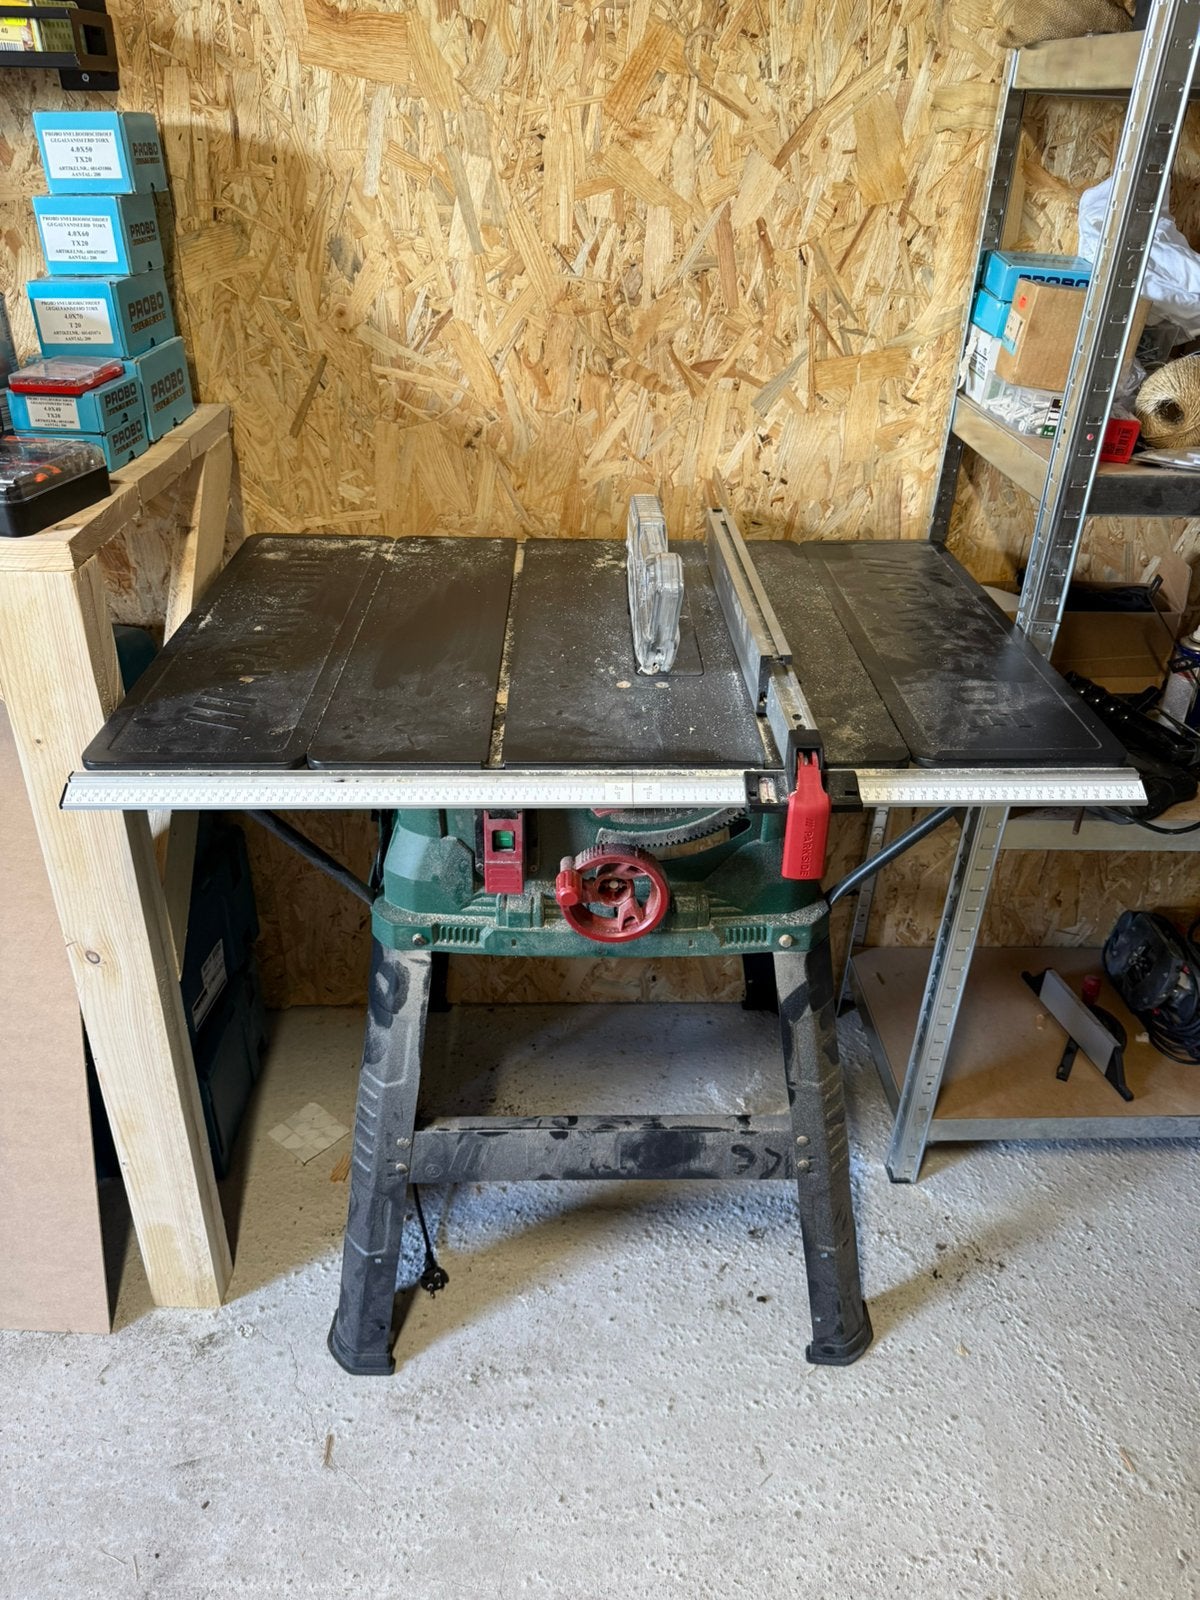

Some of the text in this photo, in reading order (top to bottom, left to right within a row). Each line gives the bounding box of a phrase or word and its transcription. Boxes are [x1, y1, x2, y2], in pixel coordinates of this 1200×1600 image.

[132, 142, 158, 156] PROBO
[129, 221, 155, 237] PROBO
[1019, 274, 1090, 287] OBO
[127, 291, 164, 321] PROBO
[105, 382, 137, 408] PROBO
[151, 368, 184, 402] PROBO
[112, 419, 143, 447] PROBO
[800, 831, 814, 877] PARKSIDE
